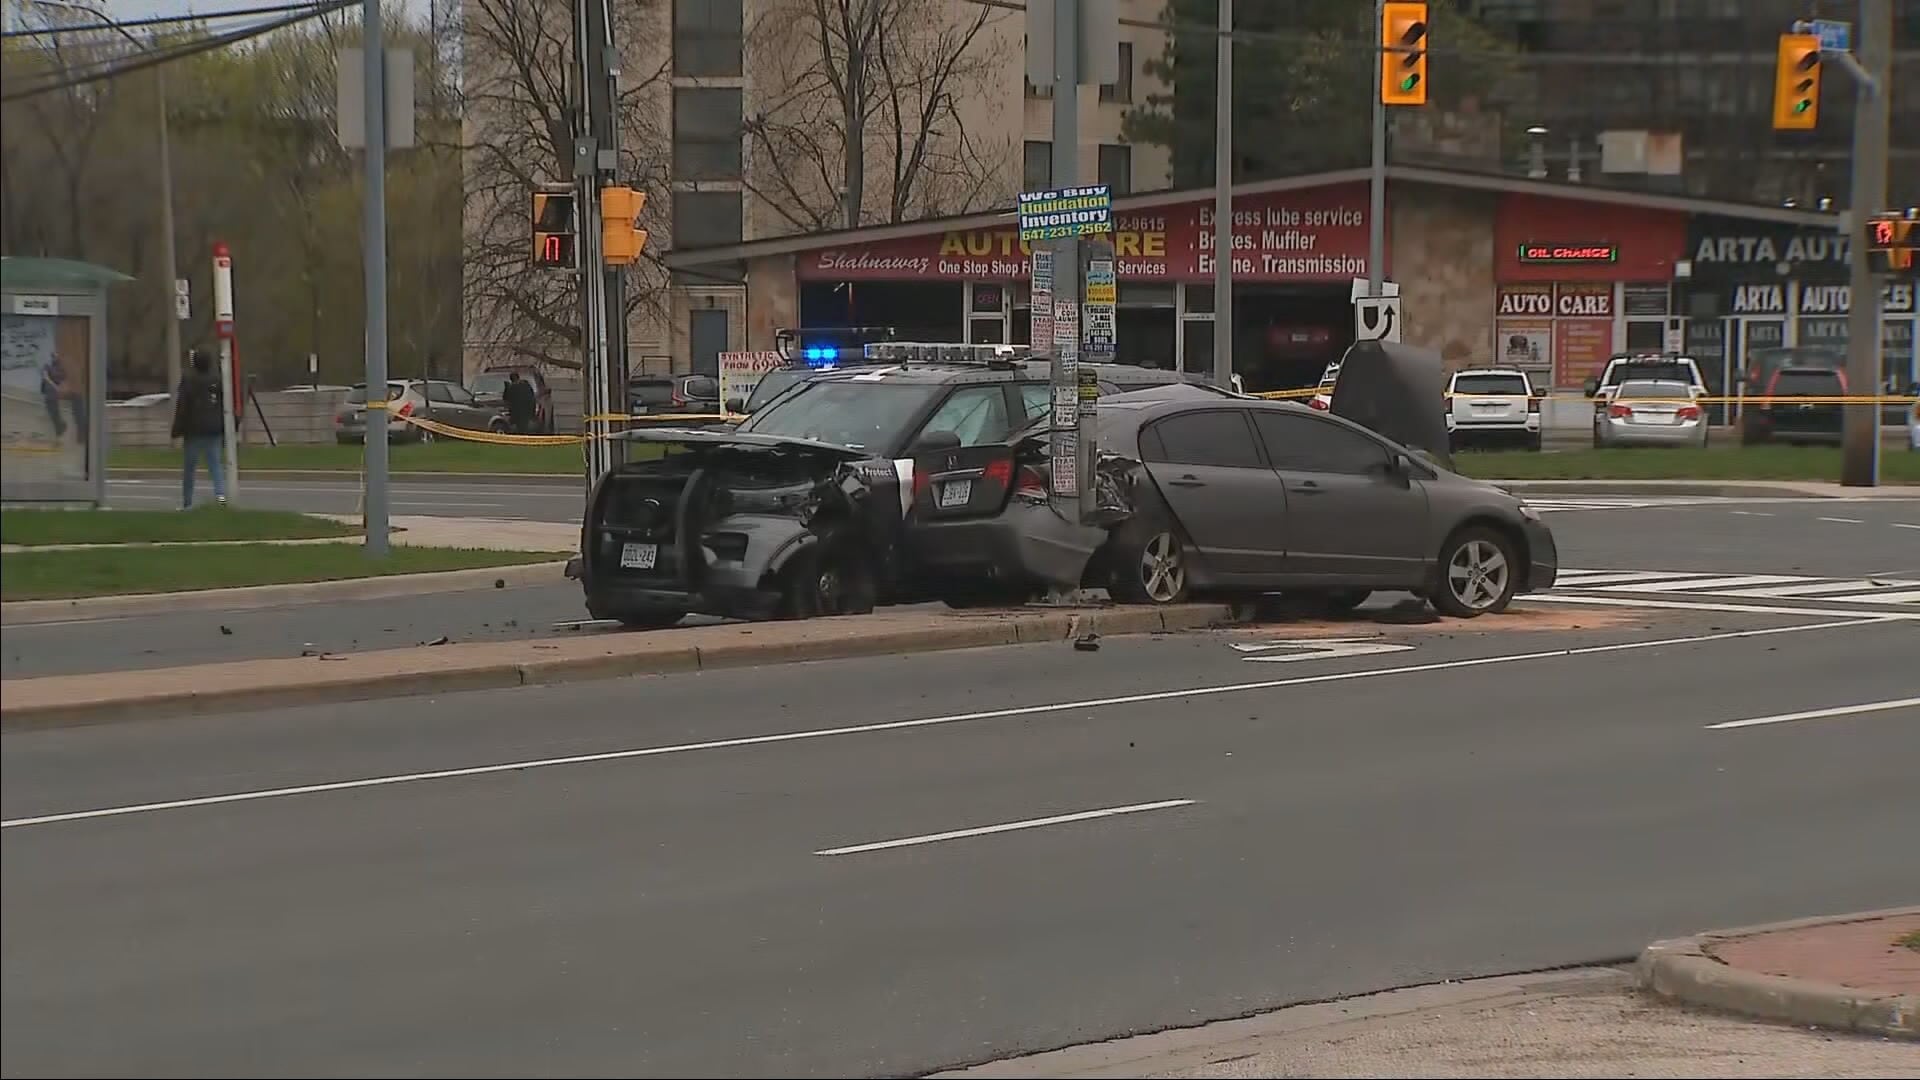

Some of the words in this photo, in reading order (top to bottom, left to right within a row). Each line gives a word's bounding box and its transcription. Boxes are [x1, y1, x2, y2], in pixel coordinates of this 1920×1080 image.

[1020, 191, 1057, 202] We
[1063, 186, 1107, 198] Buy
[1021, 196, 1108, 215] Liquidation
[1022, 209, 1108, 229] Inventory
[1200, 206, 1261, 226] Exess
[1267, 206, 1299, 226] lube
[1305, 206, 1363, 226] service
[1022, 222, 1112, 241] 647-231-2562
[1262, 230, 1316, 250] Muffler
[1528, 248, 1551, 258] OIL
[1553, 248, 1610, 258] CHANGE
[1696, 236, 1778, 262] ARTA
[1784, 236, 1850, 262] AUT
[817, 251, 929, 273] Shahnawaz
[939, 260, 961, 275] One
[964, 260, 989, 278] Stop
[991, 260, 1016, 278] Shop
[1118, 260, 1166, 275] Services
[1200, 254, 1256, 273] Enne.
[1262, 253, 1366, 273] Transmission
[1500, 294, 1551, 314] AUTO
[1560, 295, 1609, 315] CARE
[1734, 285, 1784, 312] ARTA
[721, 352, 774, 361] SYNTHETIC
[724, 361, 749, 369] FROM
[865, 466, 892, 477] Protect
